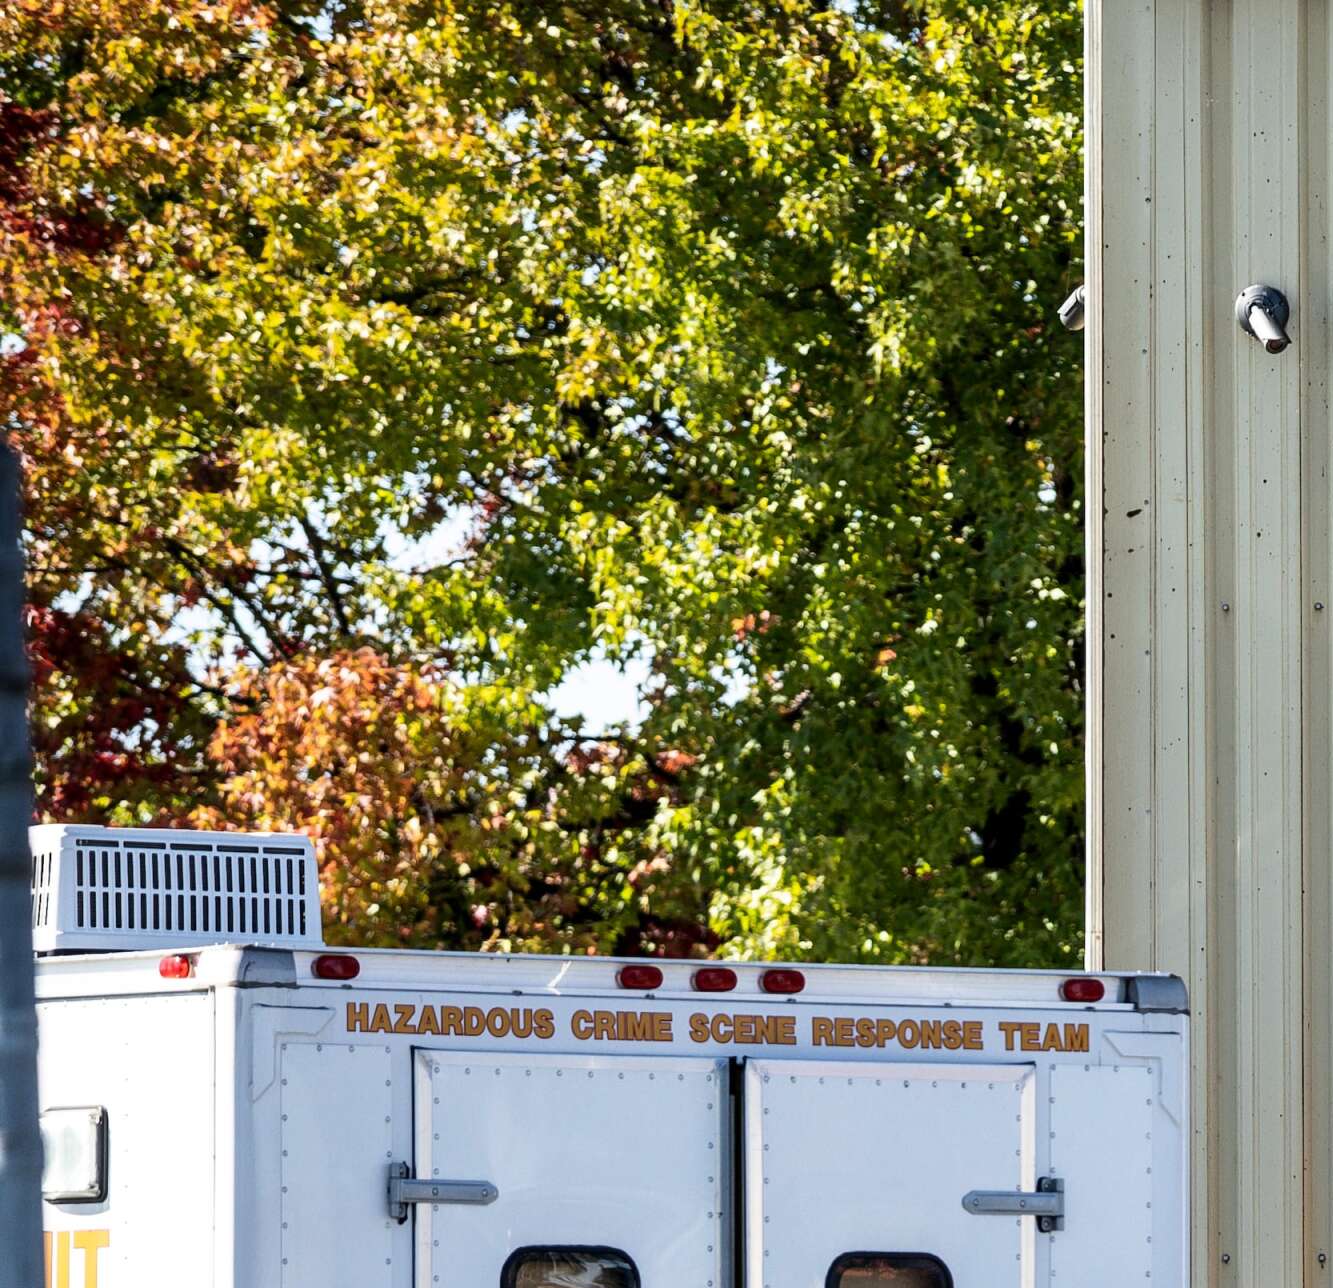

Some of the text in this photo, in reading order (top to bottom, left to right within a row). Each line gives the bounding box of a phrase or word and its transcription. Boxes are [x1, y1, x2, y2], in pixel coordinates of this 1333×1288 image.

[346, 1002, 1091, 1052] HAZARDOUS CRIME SCENE RESPONSE TEAM
